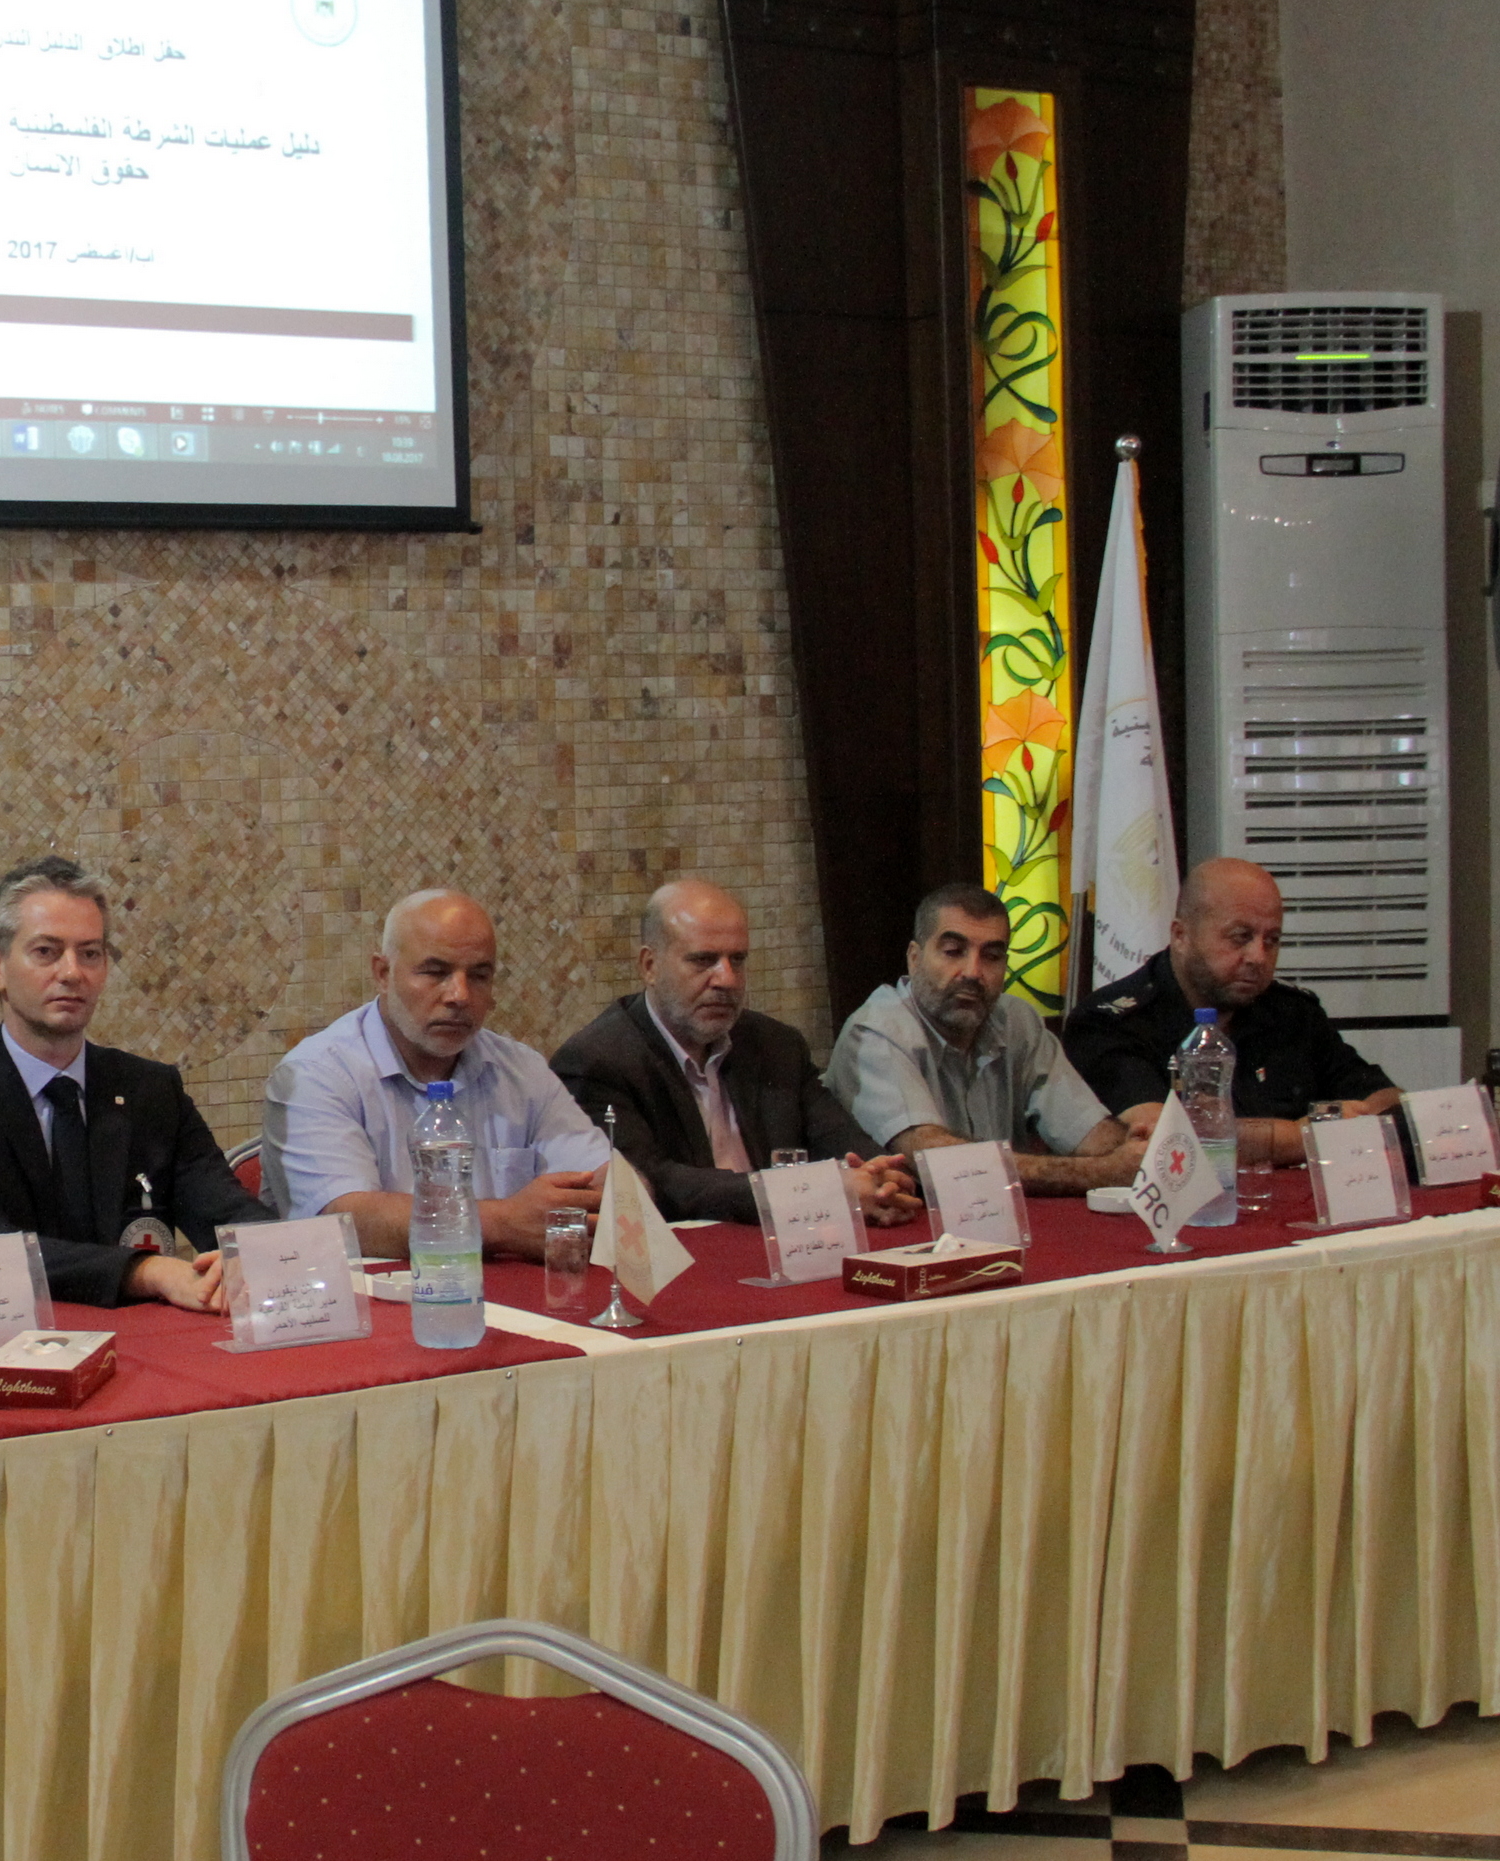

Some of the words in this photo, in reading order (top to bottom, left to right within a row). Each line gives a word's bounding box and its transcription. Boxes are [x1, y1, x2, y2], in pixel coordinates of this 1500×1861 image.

[8, 108, 113, 142] الفلسطينية
[122, 120, 195, 149] الشرطة
[204, 127, 272, 154] عمليات
[282, 135, 321, 159] دليل
[92, 159, 150, 186] حقوق
[7, 240, 58, 261] 2017
[1109, 933, 1152, 963] interio
[279, 1251, 300, 1264] السيد
[851, 1269, 896, 1287] Lighthouse
[319, 1299, 337, 1309] مدير
[300, 1312, 331, 1328] للصليب
